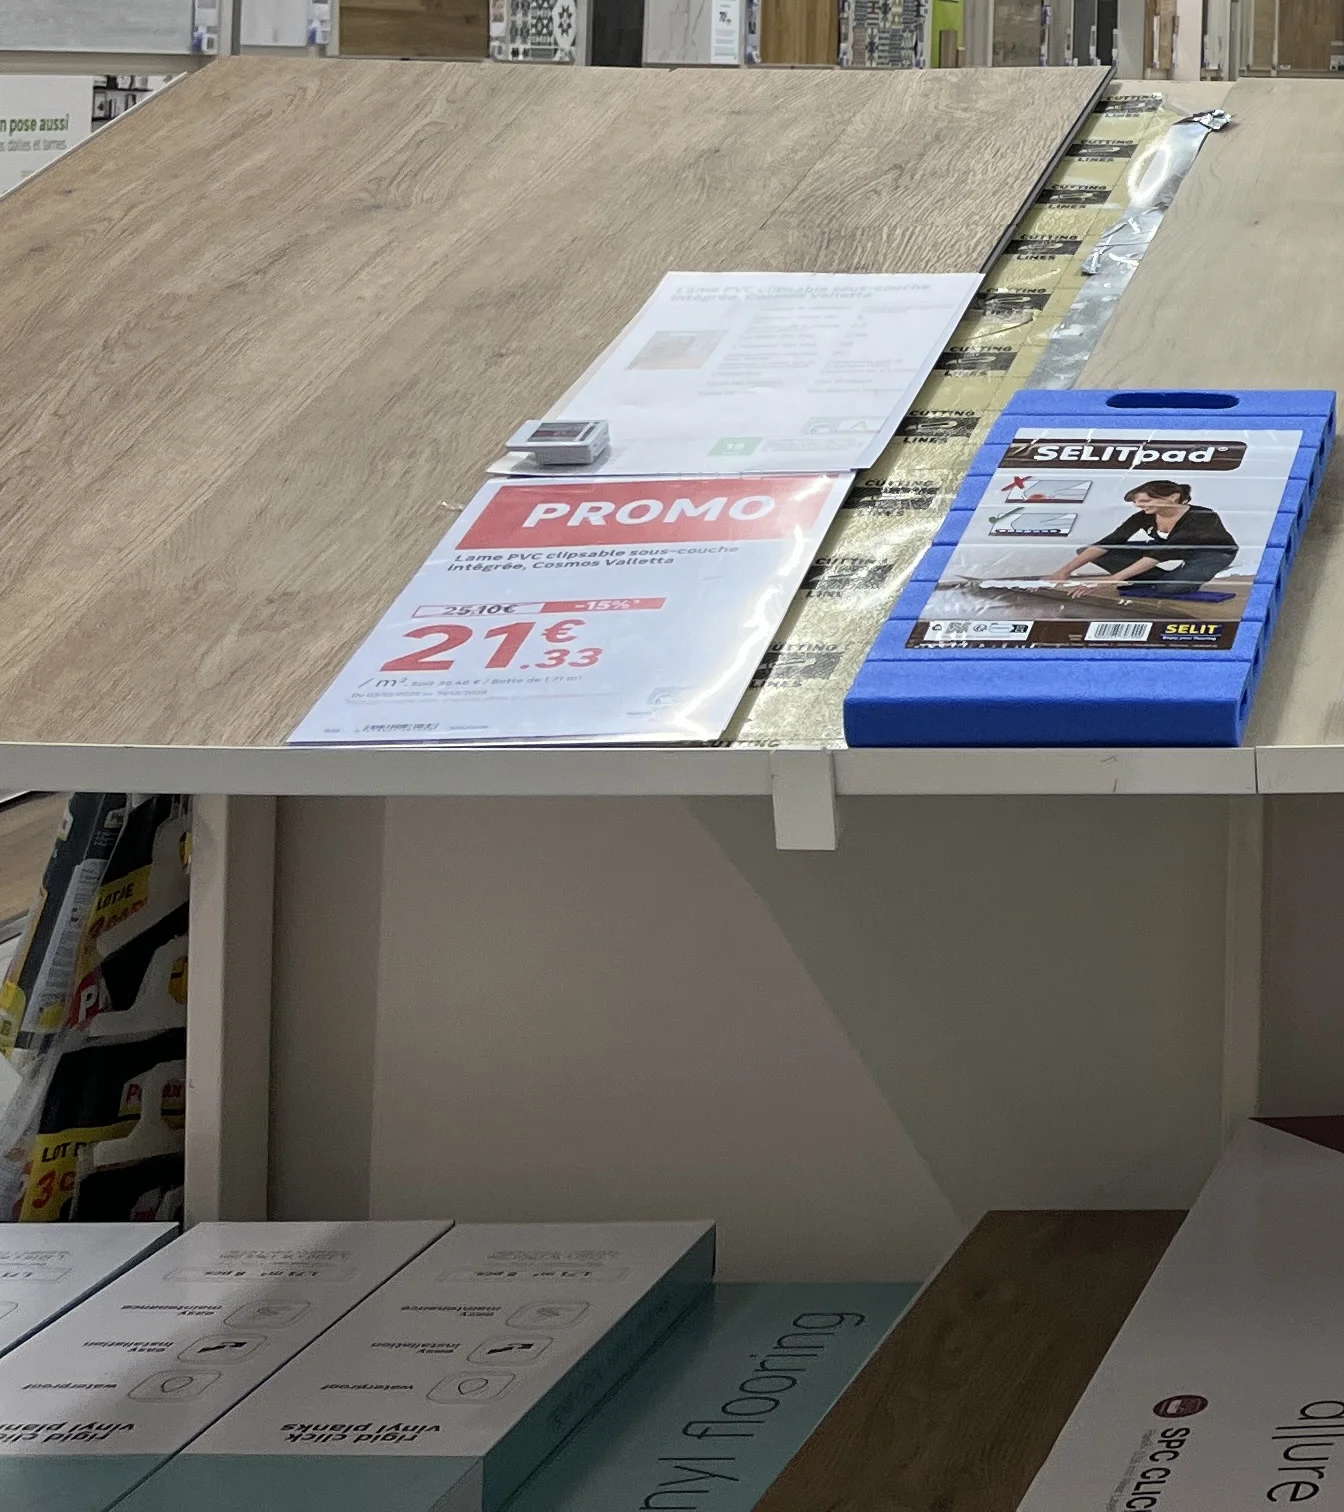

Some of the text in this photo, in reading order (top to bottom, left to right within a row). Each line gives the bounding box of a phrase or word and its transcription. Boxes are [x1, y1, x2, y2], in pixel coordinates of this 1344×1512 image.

[9, 113, 69, 136] pose aussi
[521, 495, 776, 528] PROMO
[455, 545, 740, 562] Lame PVC clipsable sous-couche
[532, 560, 600, 569] Cosmos
[605, 556, 674, 566] Valletta
[1164, 623, 1218, 634] SELIT
[770, 643, 838, 651] UTTING
[41, 1142, 68, 1163] LOT
[400, 1305, 502, 1313] maintenance
[370, 1342, 461, 1350] installation
[682, 1312, 867, 1440] flooring
[22, 1382, 117, 1390] waterproof
[320, 1383, 413, 1391] waterproof
[67, 1421, 135, 1434] vinyl
[280, 1422, 441, 1435] vinyl planks
[40, 1431, 112, 1444] rigid
[285, 1432, 419, 1445] rigid click
[1122, 1426, 1191, 1512] SPC CLIC
